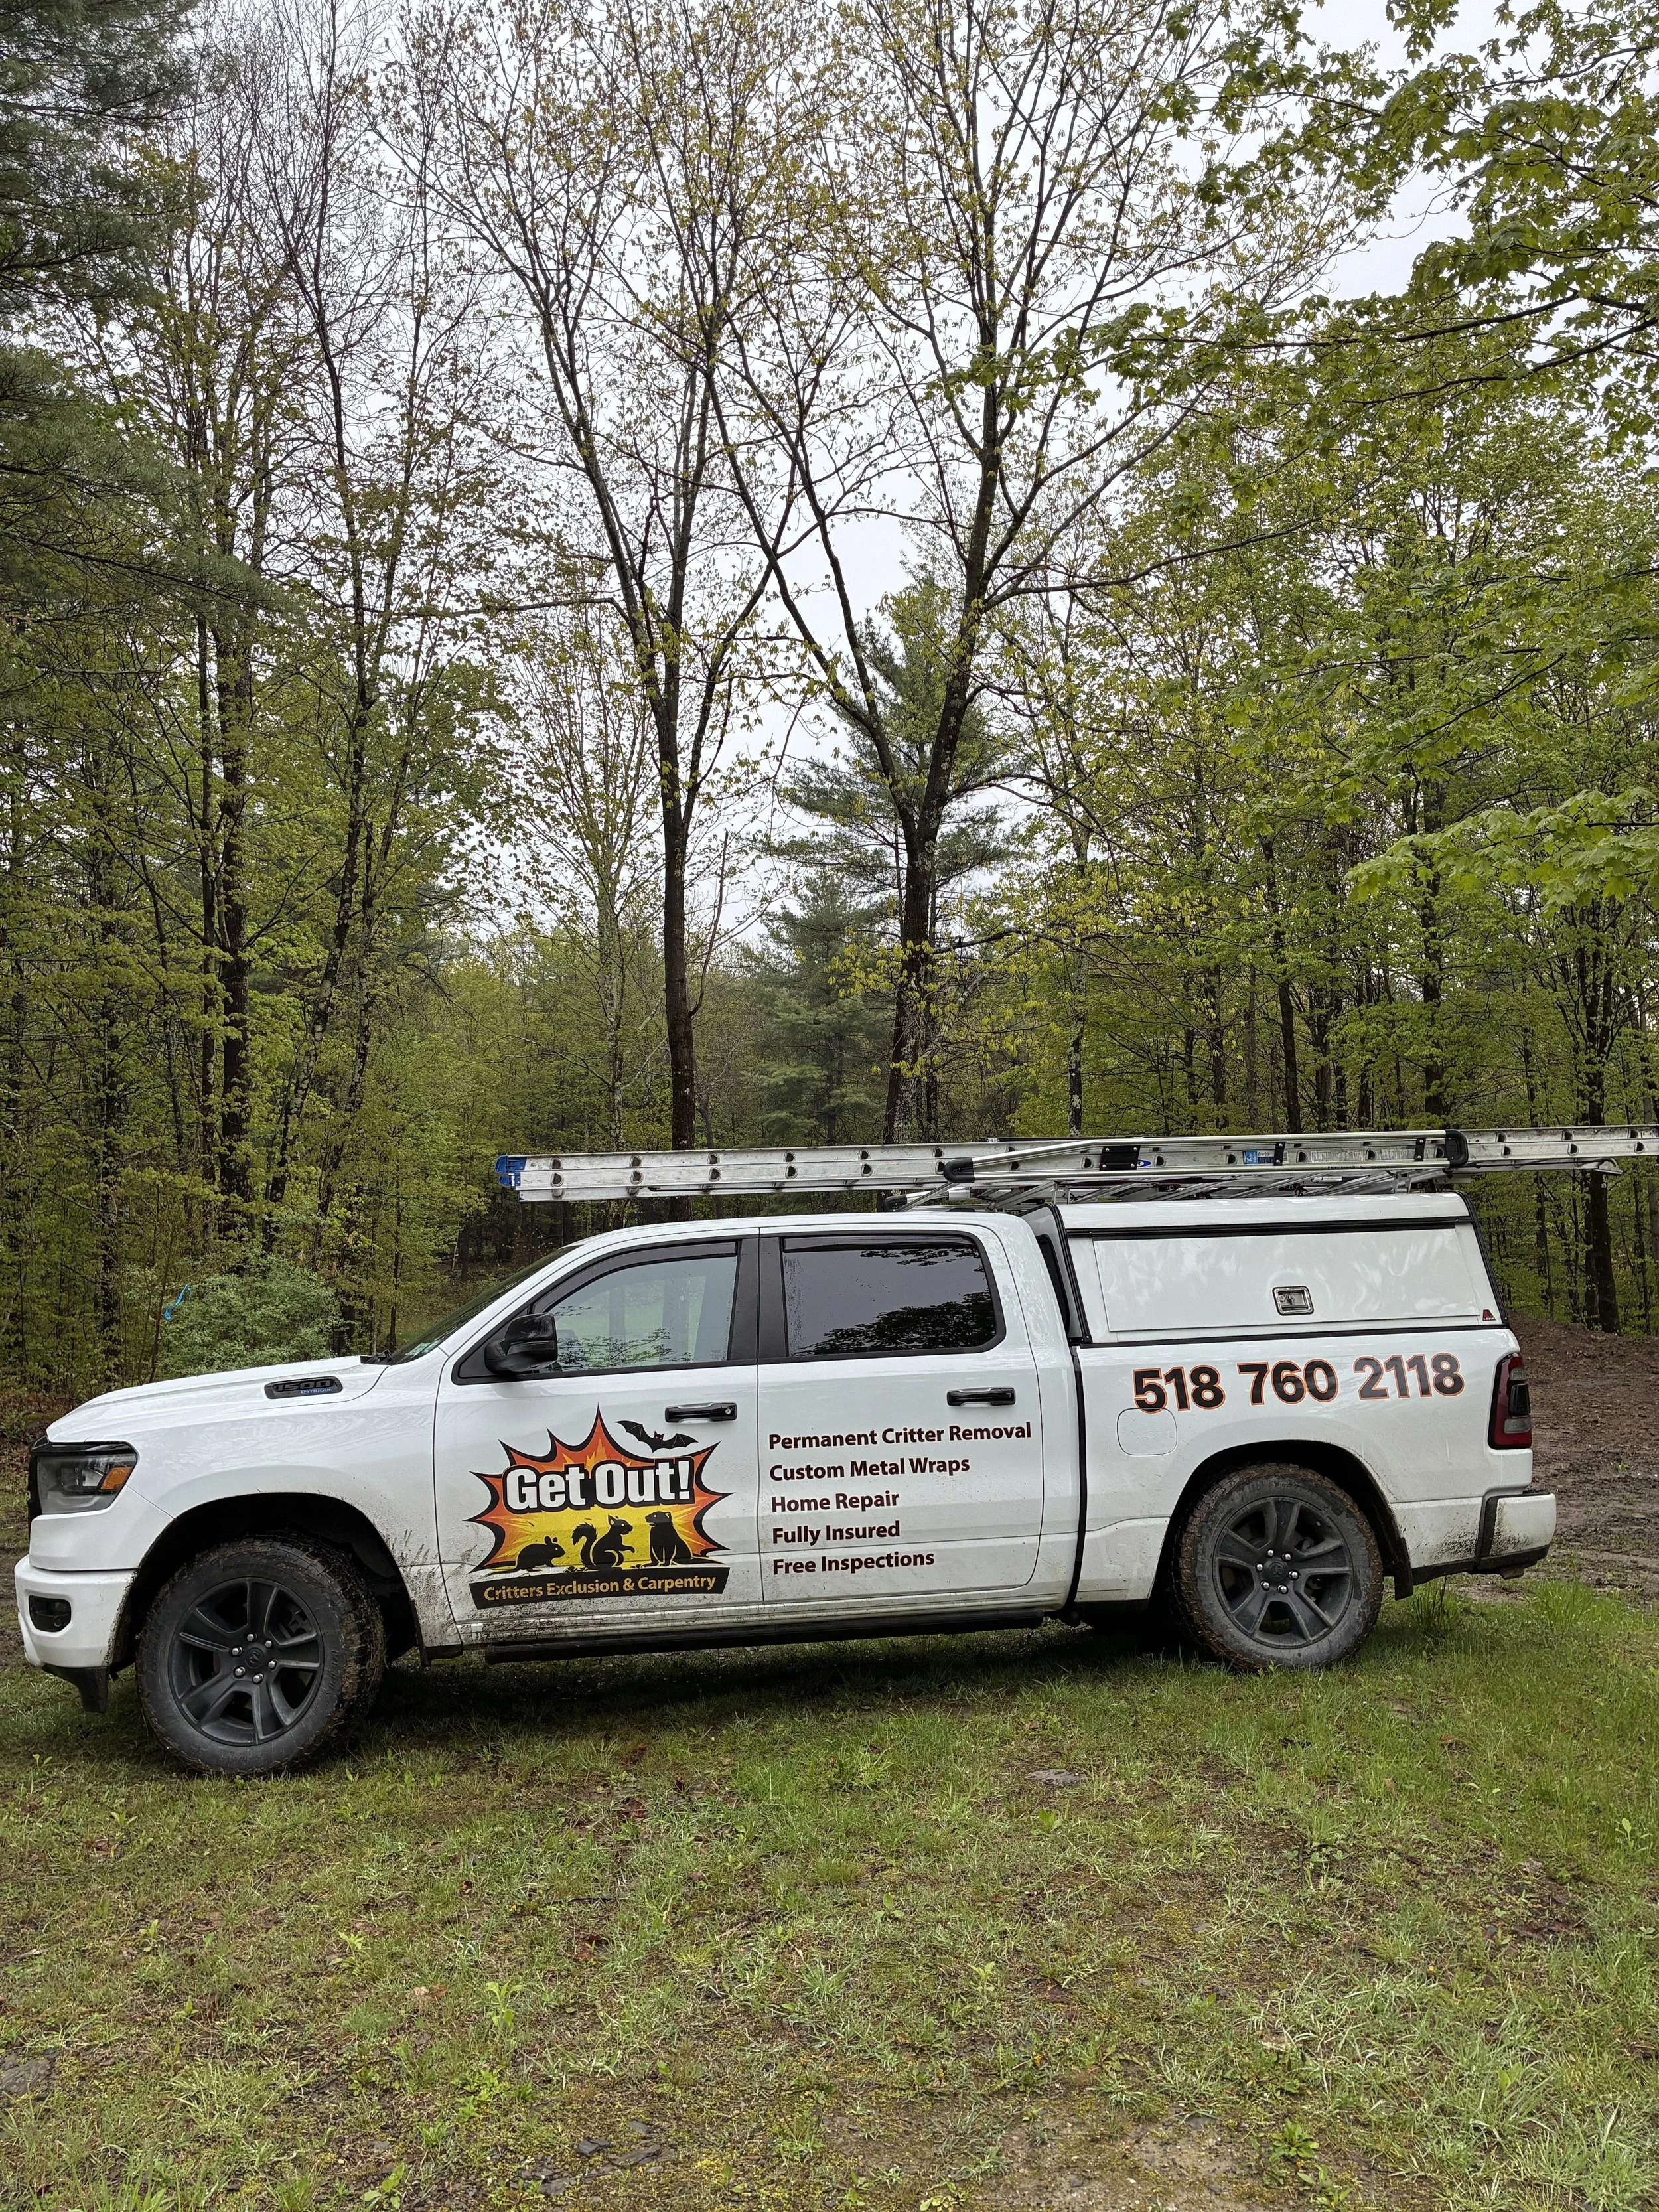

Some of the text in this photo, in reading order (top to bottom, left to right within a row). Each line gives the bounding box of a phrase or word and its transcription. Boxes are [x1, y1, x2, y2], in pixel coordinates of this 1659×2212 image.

[276, 1381, 330, 1391] 1500
[1132, 1353, 1465, 1414] 518 760 2118
[769, 1421, 1031, 1450] Permanent Critter Removal
[769, 1457, 970, 1481] Custom Metal Wraps
[506, 1460, 690, 1509] Get Out!
[771, 1490, 900, 1513] Home Repair
[772, 1520, 900, 1547] Fully Insured
[773, 1551, 935, 1576] Free Inspections
[484, 1575, 716, 1601] Critters Exclusion & Carpentry
